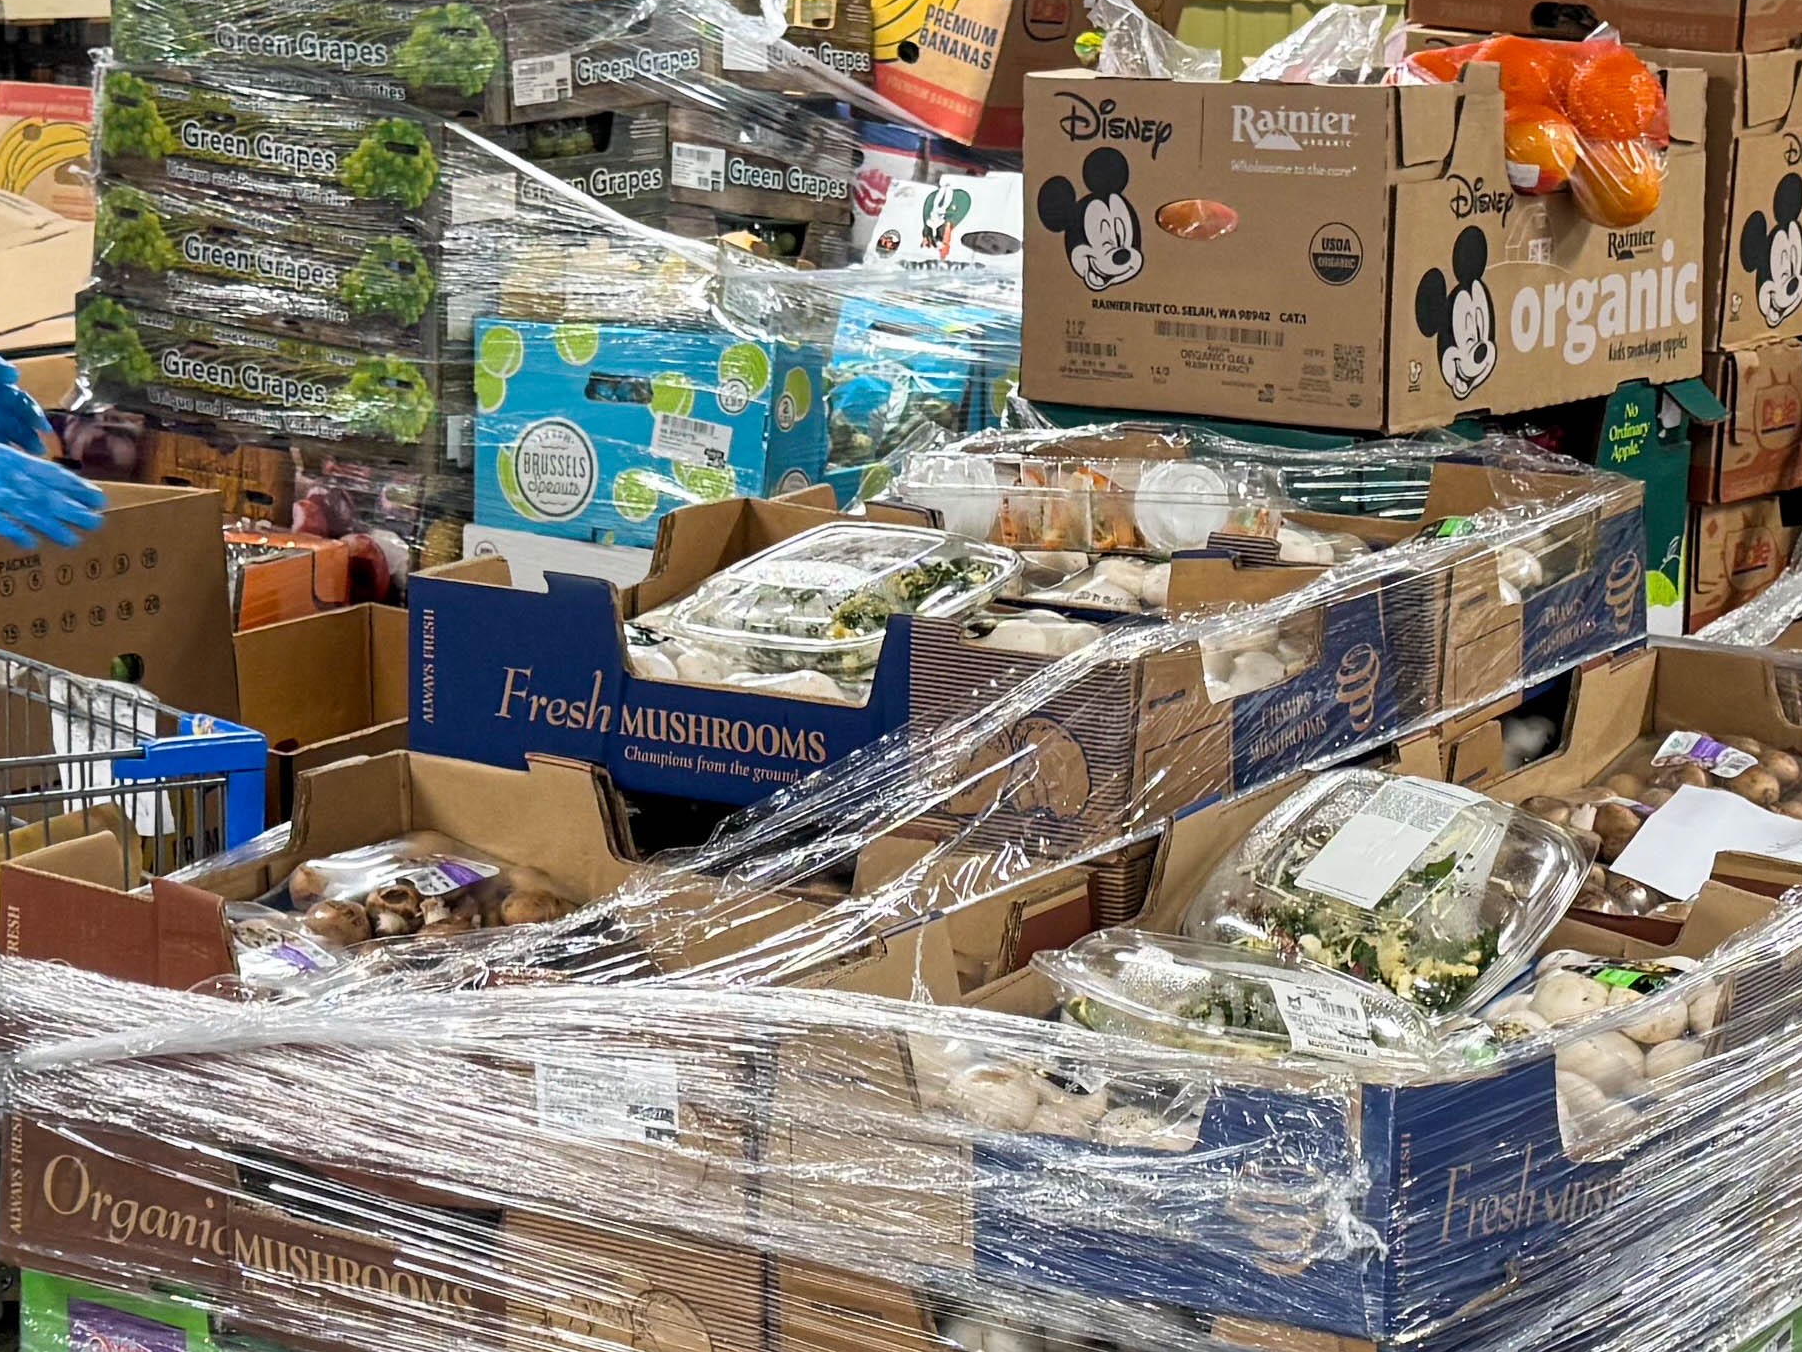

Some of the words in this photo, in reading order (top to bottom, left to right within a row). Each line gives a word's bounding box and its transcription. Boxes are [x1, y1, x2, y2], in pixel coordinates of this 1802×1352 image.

[925, 4, 998, 47] PREMIUM
[215, 23, 294, 55] Green
[298, 31, 387, 71] Grapes
[576, 55, 634, 86] Green
[637, 47, 699, 79] Grapes
[820, 43, 870, 73] Grapes
[919, 32, 992, 70] BANANAS
[1230, 104, 1356, 144] Rainier
[182, 120, 249, 158] Green
[254, 134, 336, 173] Grapes
[591, 166, 662, 199] Grapes
[729, 159, 783, 189] Green
[787, 165, 848, 199] Grapes
[183, 234, 249, 271] Green
[255, 250, 337, 288] Grapes
[1321, 238, 1352, 252] USDA
[1607, 229, 1655, 258] Rainier
[1092, 299, 1132, 312] RAINIER
[1218, 308, 1237, 320] WA
[1511, 239, 1698, 365] organic
[161, 349, 234, 387] Green
[241, 365, 327, 406] Grapes
[1624, 403, 1639, 418] No
[1609, 422, 1650, 441] Ordinary
[523, 451, 587, 478] BRUSSELS
[527, 469, 581, 498] Sprouts
[423, 609, 434, 659] FRESH
[422, 663, 434, 724] ALWAYS
[495, 666, 612, 733] Fresh
[619, 703, 827, 763] MUSHROOMS
[624, 745, 693, 770] Champions
[696, 755, 726, 775] from
[730, 760, 750, 778] the
[9, 1168, 23, 1235] ALWAYS
[1442, 1142, 1535, 1244] Fresh
[43, 1153, 230, 1255] Organic
[234, 1227, 475, 1317] MUSHROOMS
